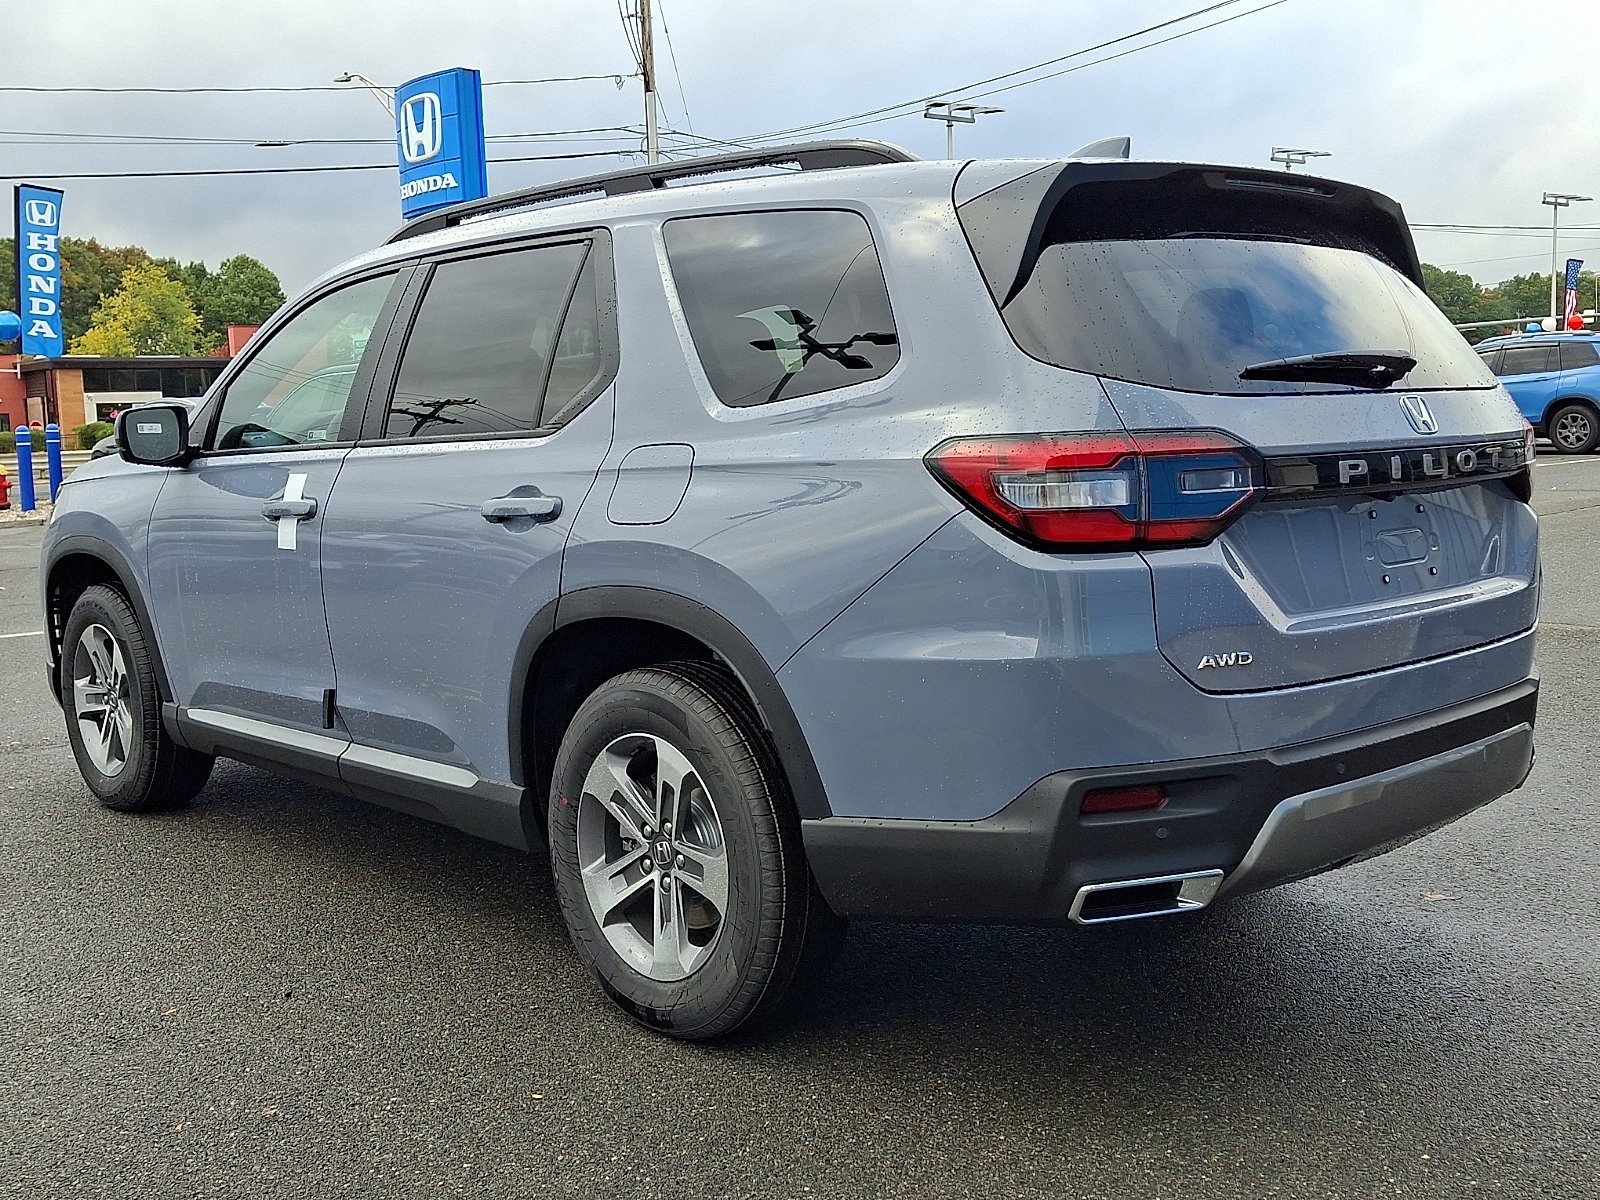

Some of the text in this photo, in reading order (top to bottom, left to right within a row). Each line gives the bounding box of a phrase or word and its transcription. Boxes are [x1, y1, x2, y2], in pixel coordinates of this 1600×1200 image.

[400, 172, 459, 201] HONDA
[26, 232, 58, 339] HONDA
[1338, 447, 1503, 485] PILOT
[1197, 650, 1254, 670] AWD
